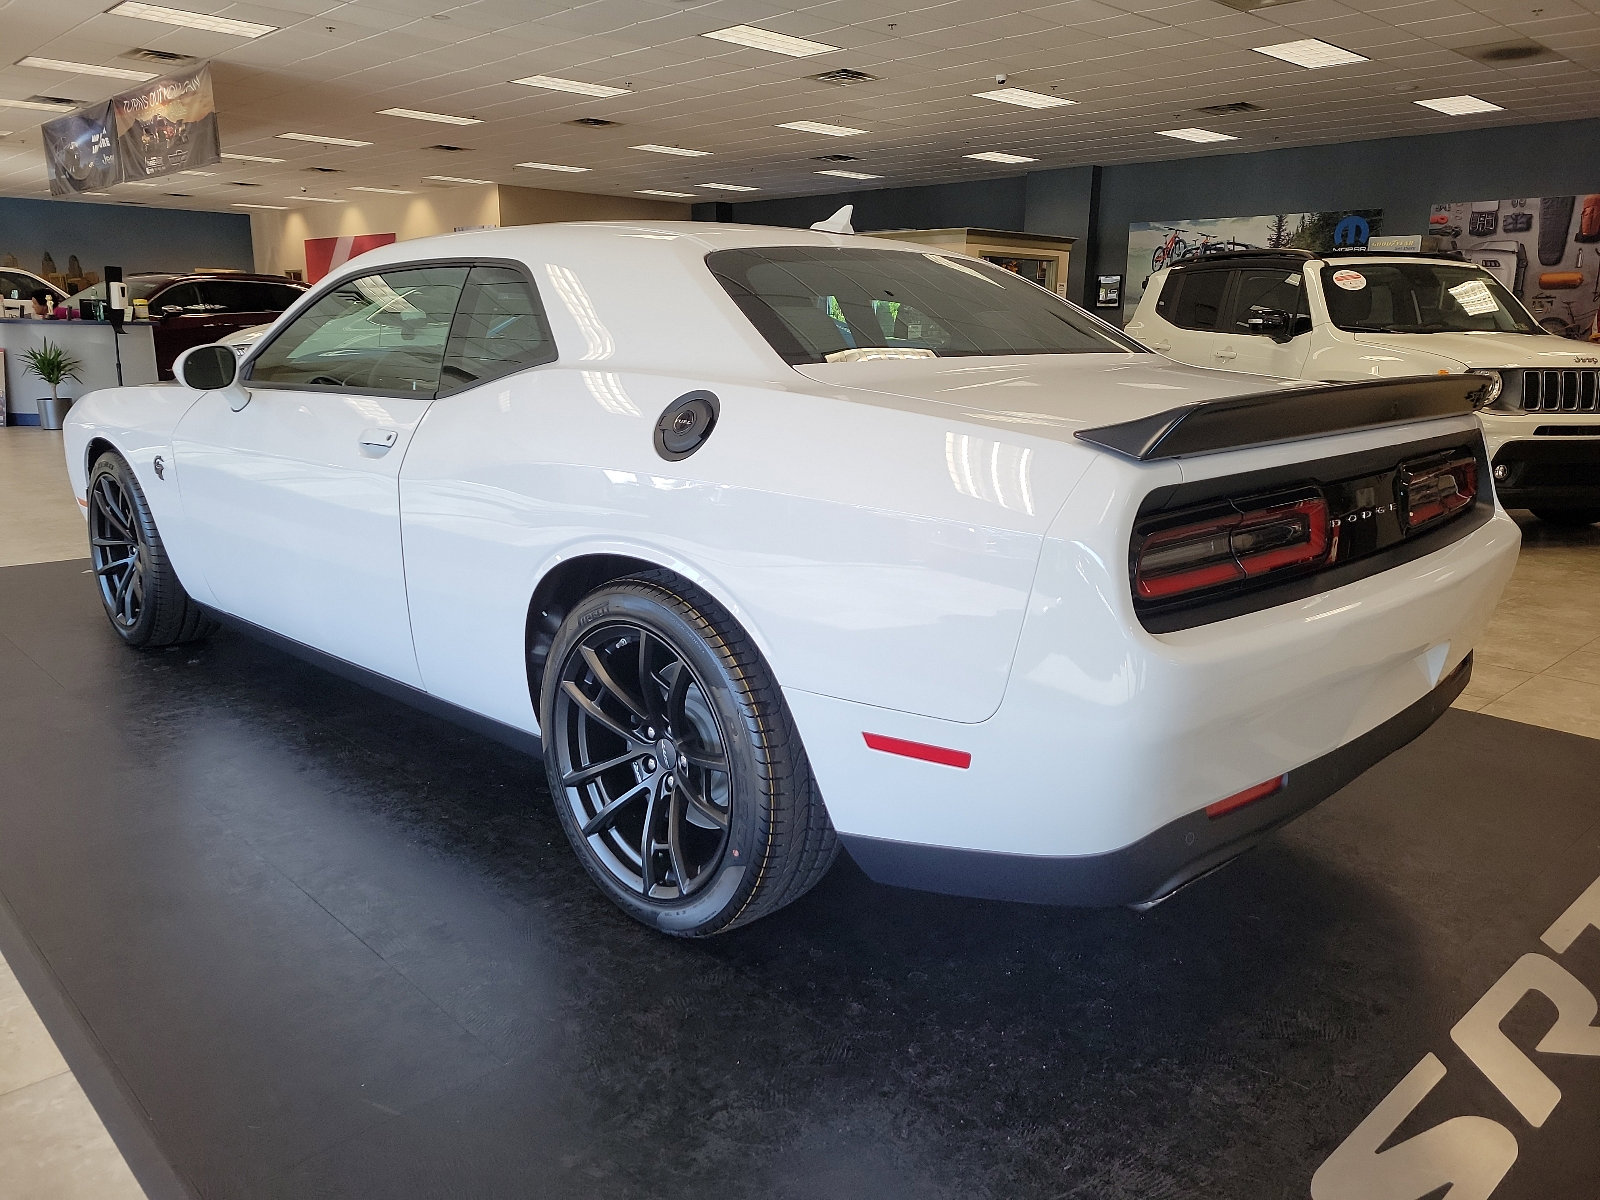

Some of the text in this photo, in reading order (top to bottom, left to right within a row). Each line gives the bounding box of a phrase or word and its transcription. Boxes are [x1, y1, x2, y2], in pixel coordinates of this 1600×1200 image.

[123, 96, 149, 113] TURNS
[149, 84, 163, 107] OUT
[1573, 355, 1599, 365] Jeep
[1329, 502, 1398, 528] DODGE
